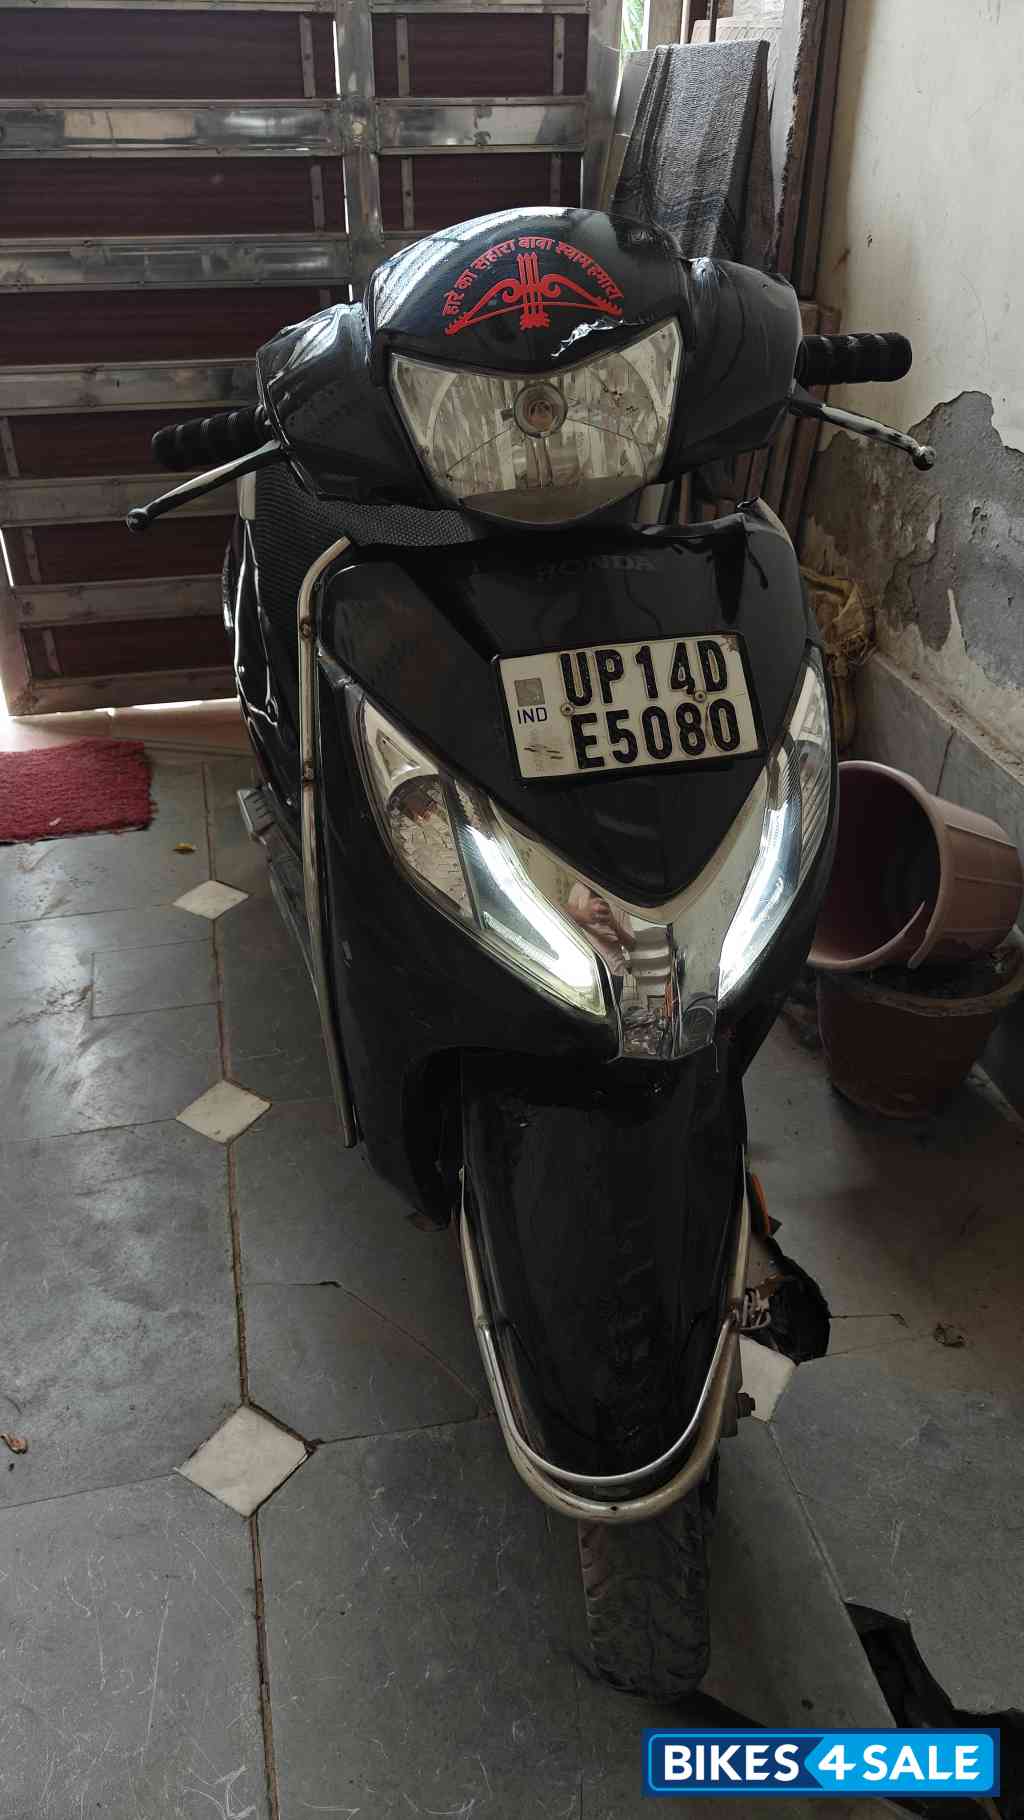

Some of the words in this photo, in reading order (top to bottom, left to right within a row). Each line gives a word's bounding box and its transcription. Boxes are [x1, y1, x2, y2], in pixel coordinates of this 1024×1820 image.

[455, 269, 478, 290] का
[471, 239, 515, 270] सहारा
[560, 639, 728, 706] UP14D
[517, 706, 548, 724] IND
[571, 698, 740, 769] E5080
